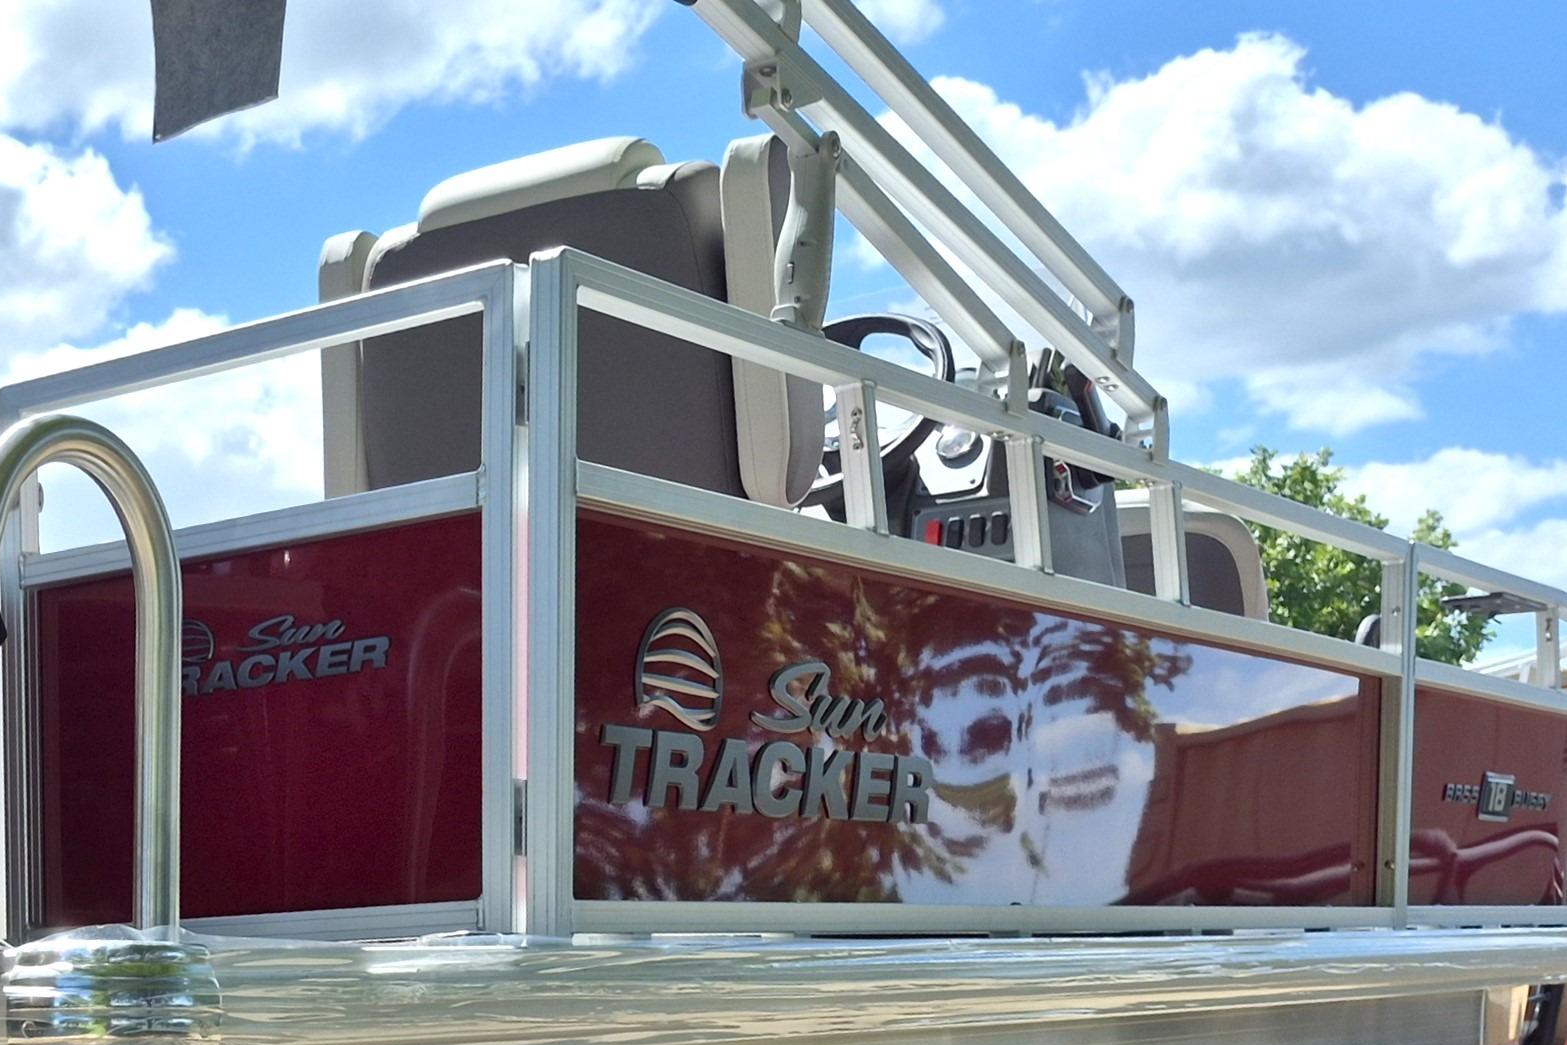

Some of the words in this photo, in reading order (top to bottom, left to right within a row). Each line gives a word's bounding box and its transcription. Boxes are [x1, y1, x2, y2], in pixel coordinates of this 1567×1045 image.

[235, 614, 346, 653] Sun
[182, 634, 390, 696] RACKER
[750, 661, 888, 742] Sun
[600, 723, 934, 824] TRACKER
[1488, 783, 1507, 811] 18
